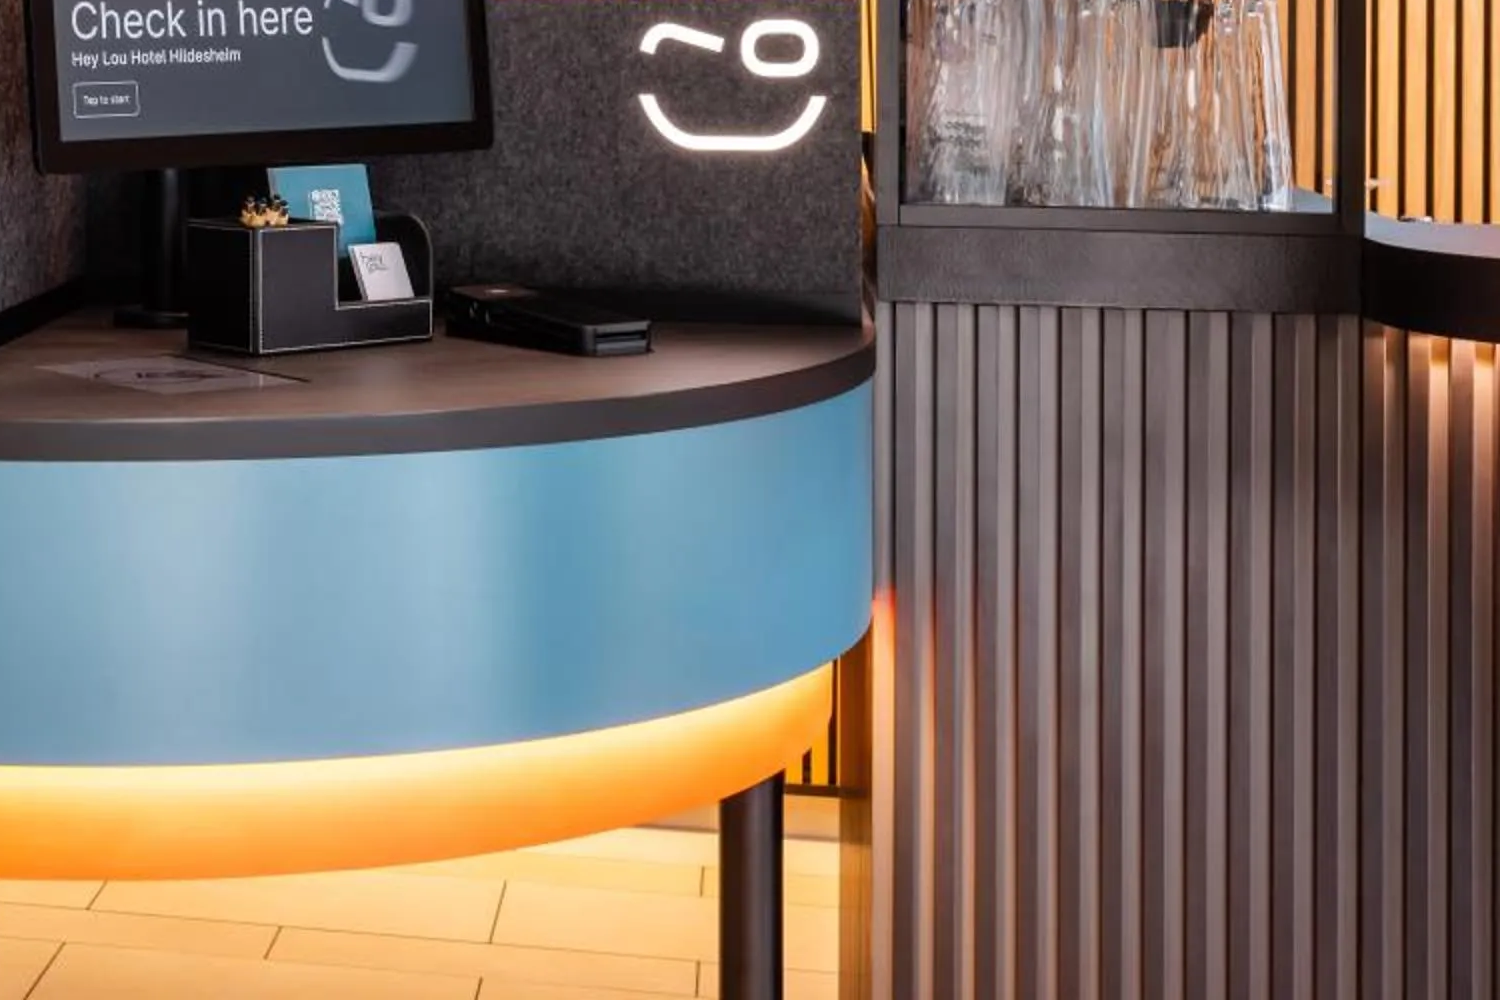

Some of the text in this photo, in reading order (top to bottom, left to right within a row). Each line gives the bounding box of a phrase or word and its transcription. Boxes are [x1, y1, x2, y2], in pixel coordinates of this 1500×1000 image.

[71, 0, 187, 40] Check
[71, 46, 242, 69] Hey Lou Hotel Hildesheim
